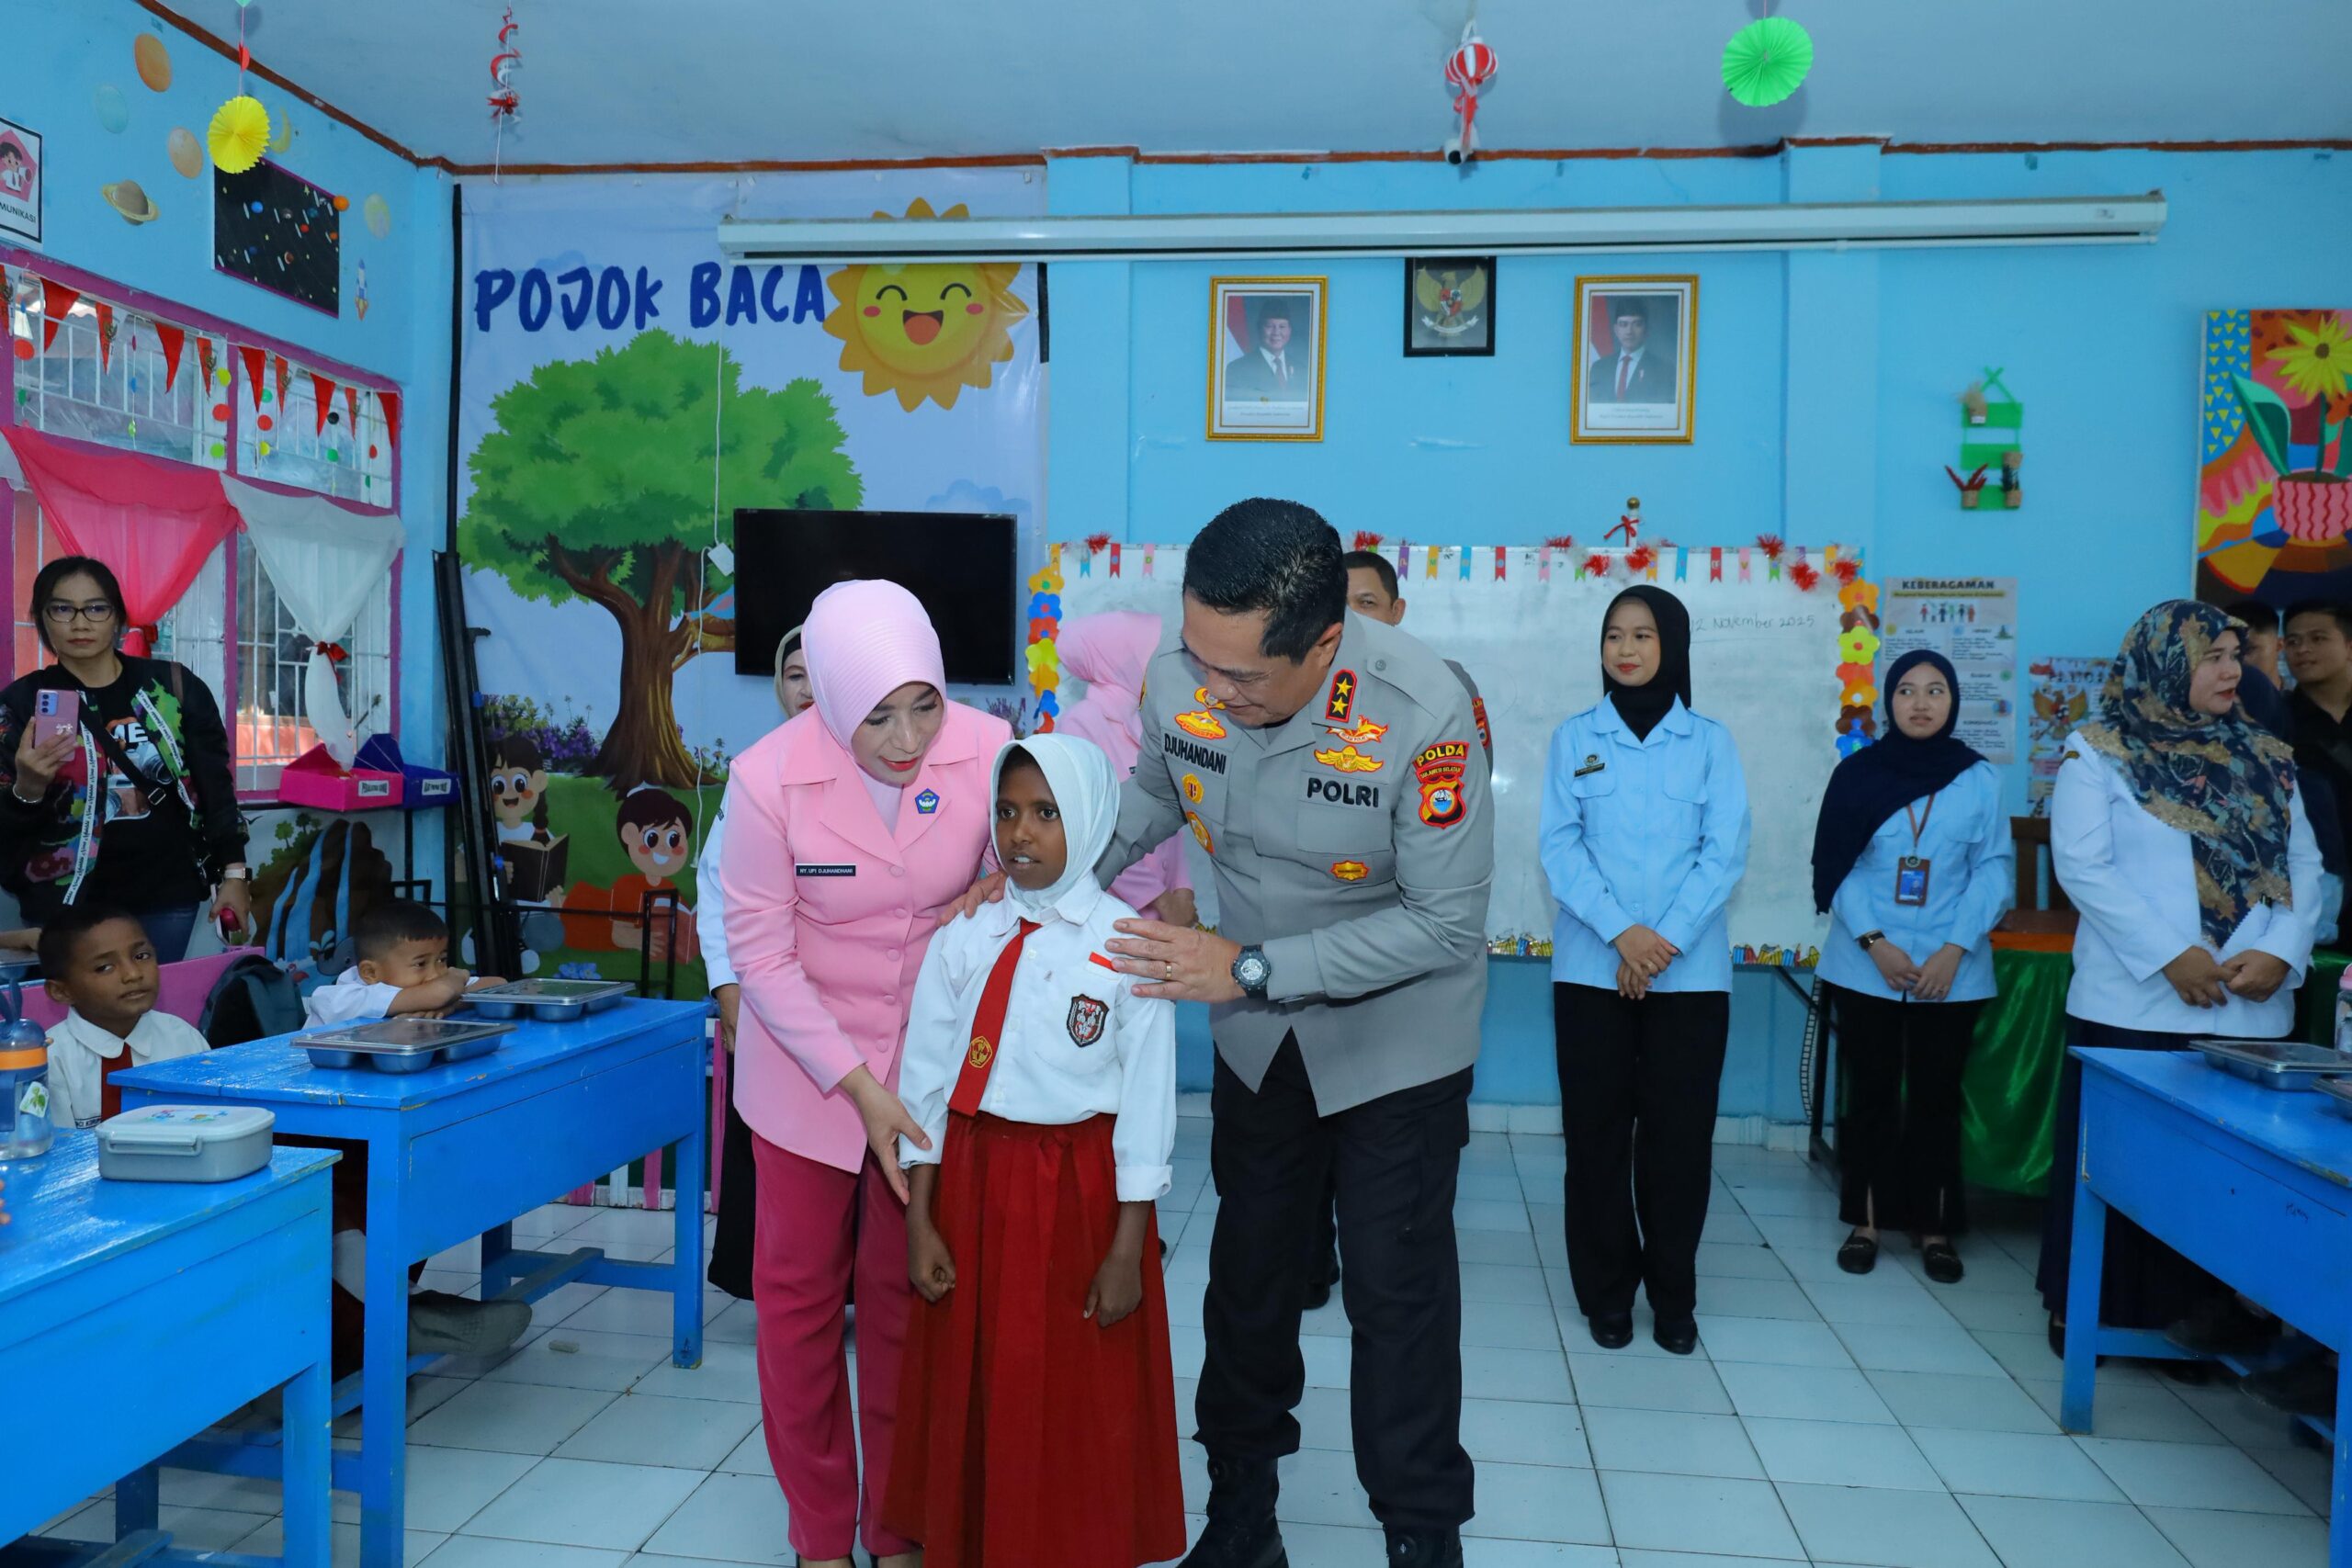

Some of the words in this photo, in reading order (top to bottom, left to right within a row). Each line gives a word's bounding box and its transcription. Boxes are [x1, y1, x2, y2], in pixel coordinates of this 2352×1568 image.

[474, 265, 663, 332] POJOK
[690, 261, 825, 329] BACA
[1902, 580, 1995, 590] KEBERAGAMAN
[1713, 613, 1772, 629] November
[1780, 615, 1815, 628] 2025
[1164, 733, 1227, 775] DJUHANDANI
[1417, 744, 1465, 766] POLDA
[1307, 777, 1379, 808] POLRI
